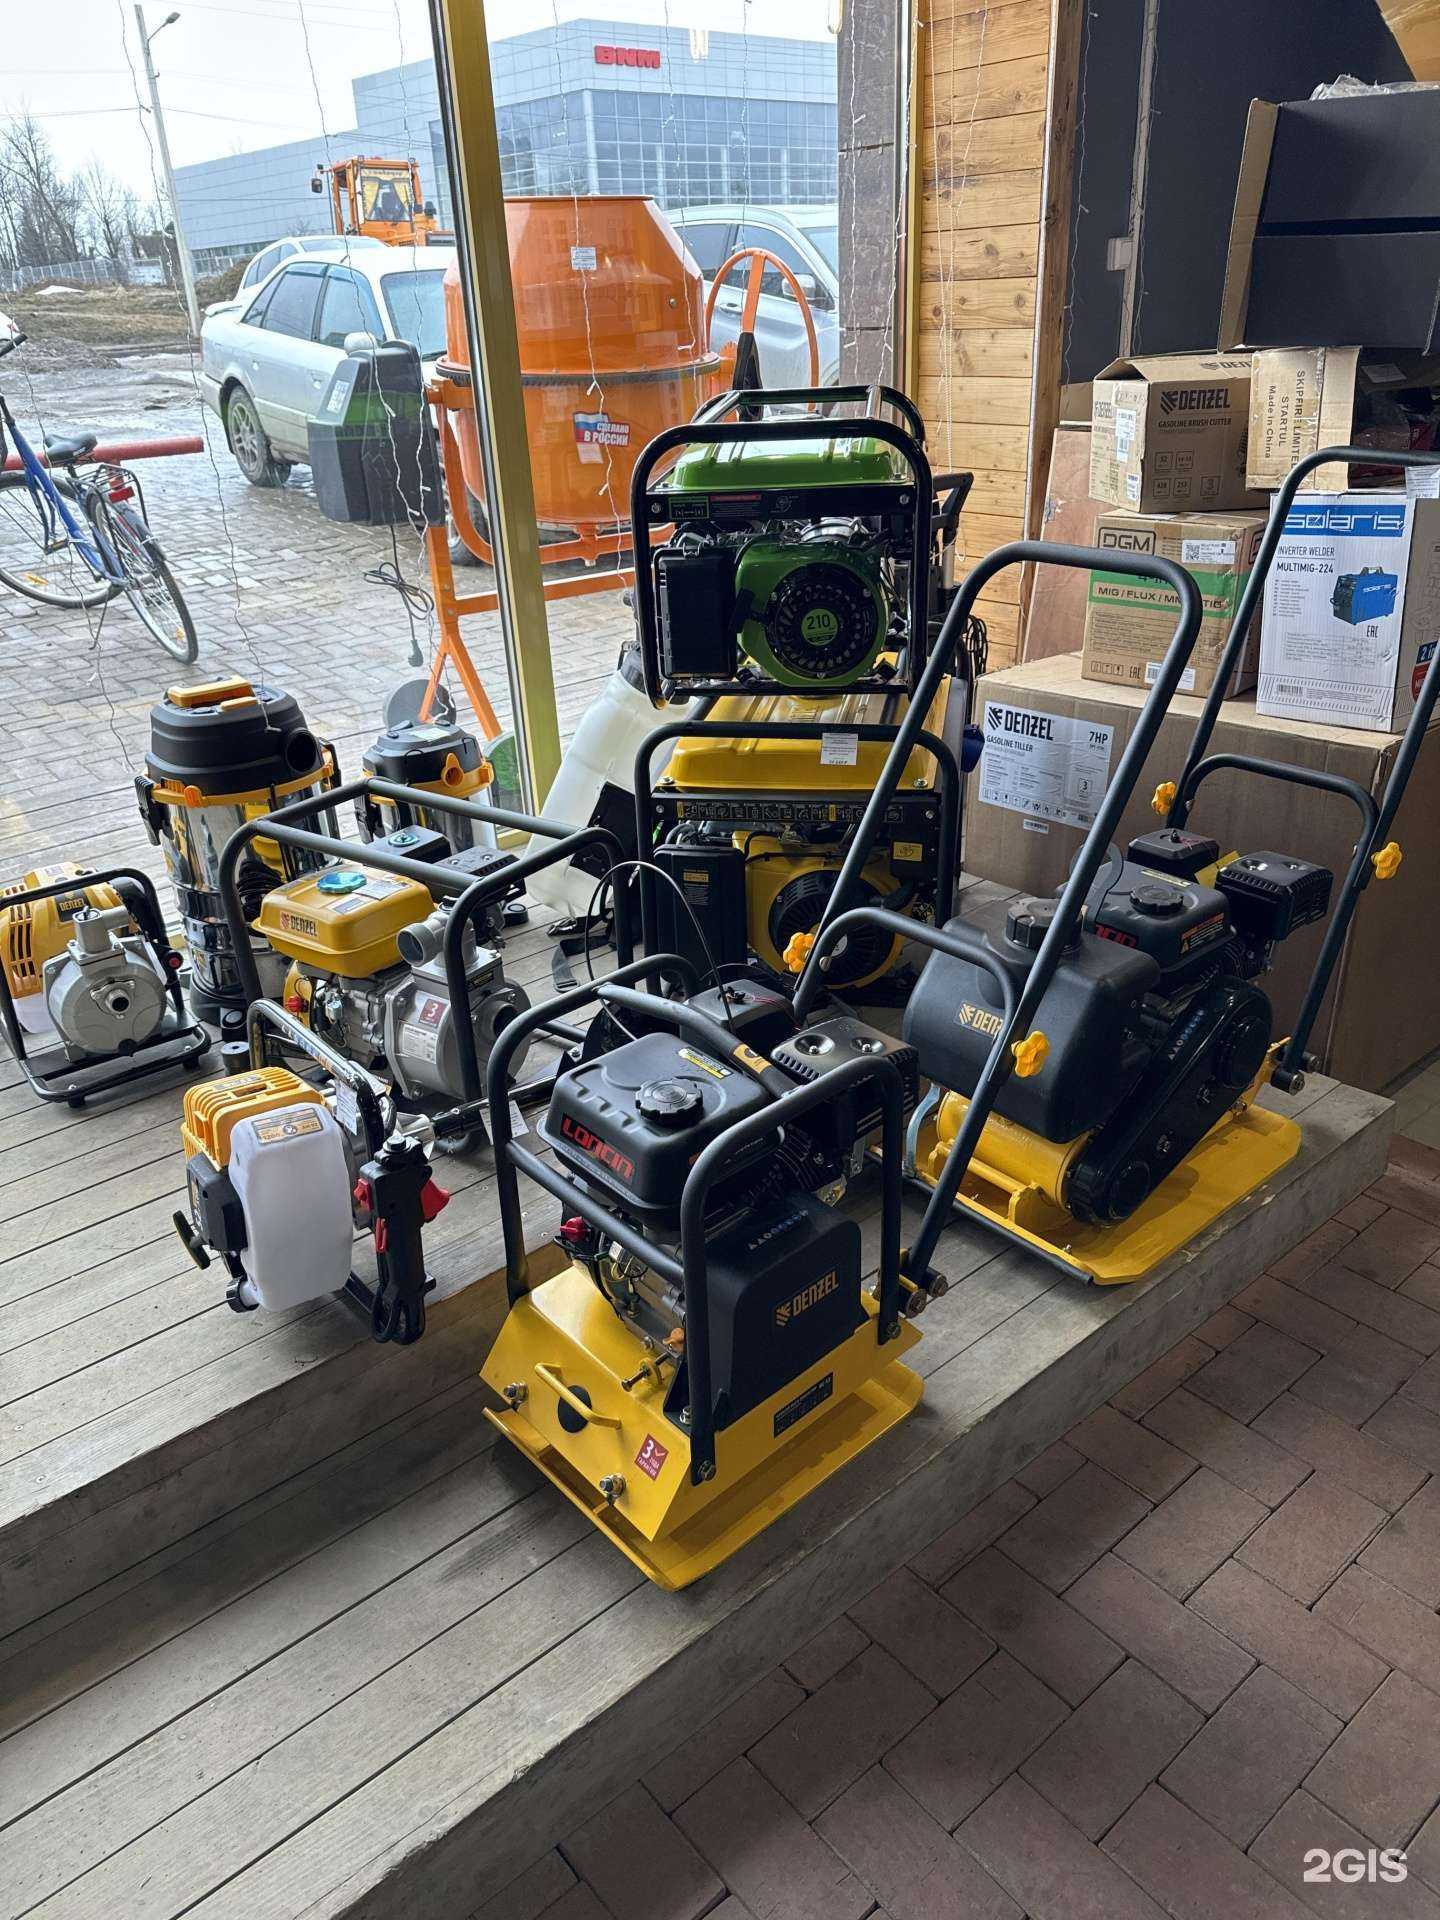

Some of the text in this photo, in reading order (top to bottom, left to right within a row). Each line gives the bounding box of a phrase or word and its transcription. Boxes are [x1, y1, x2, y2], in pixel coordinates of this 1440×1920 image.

[1177, 388, 1231, 410] DENZEL
[1268, 386, 1276, 413] Made
[597, 422, 629, 434] СДЕЛАНО
[1158, 418, 1232, 428] GASOLINE BRUSH CUTTER
[1278, 396, 1289, 447] STARTUL
[1291, 370, 1305, 468] SKIPFIRE LIMITE
[584, 431, 629, 446] В РОССИИ
[1265, 428, 1274, 458] China
[1103, 533, 1150, 551] DGM
[1278, 545, 1335, 556] INVERTER WELDER
[1277, 563, 1334, 574] MULTIMIG-224
[1098, 587, 1118, 597] MIG
[1127, 592, 1156, 601] FLUX
[1204, 600, 1223, 609] TIG
[807, 614, 830, 631] 210
[1004, 710, 1054, 741] DENZEL
[986, 735, 1034, 752] GASOLINE TILLER
[1089, 731, 1109, 745] 7HP
[59, 898, 84, 912] DENZEL
[290, 916, 318, 937] DENZEL
[428, 1004, 438, 1018] 3
[792, 1270, 840, 1317] DENZEL
[641, 1438, 654, 1460] 3
